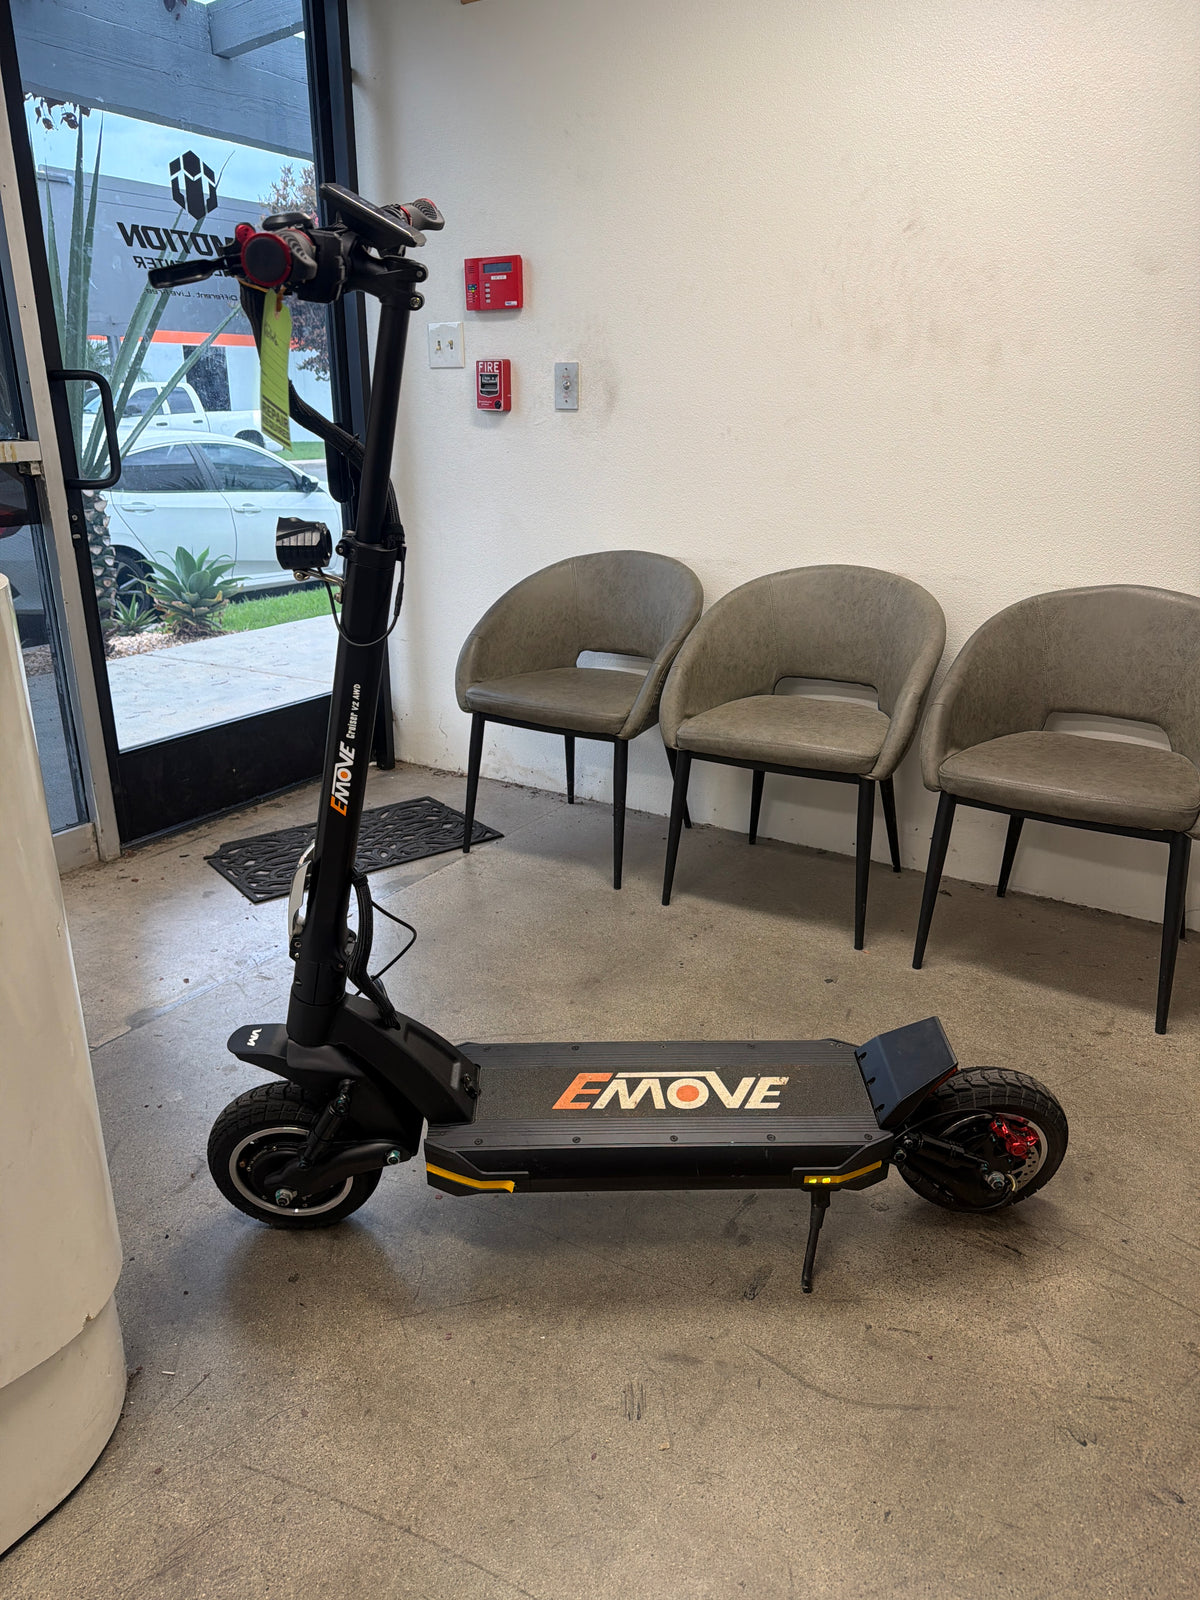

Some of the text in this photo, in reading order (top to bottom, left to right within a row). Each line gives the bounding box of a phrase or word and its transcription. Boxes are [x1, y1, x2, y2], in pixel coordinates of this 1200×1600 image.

[478, 361, 500, 373] FIRE
[262, 401, 289, 429] REPAIR
[330, 683, 361, 816] EMOVE Cruiser V2 AWD
[552, 1071, 790, 1110] EMOVE
